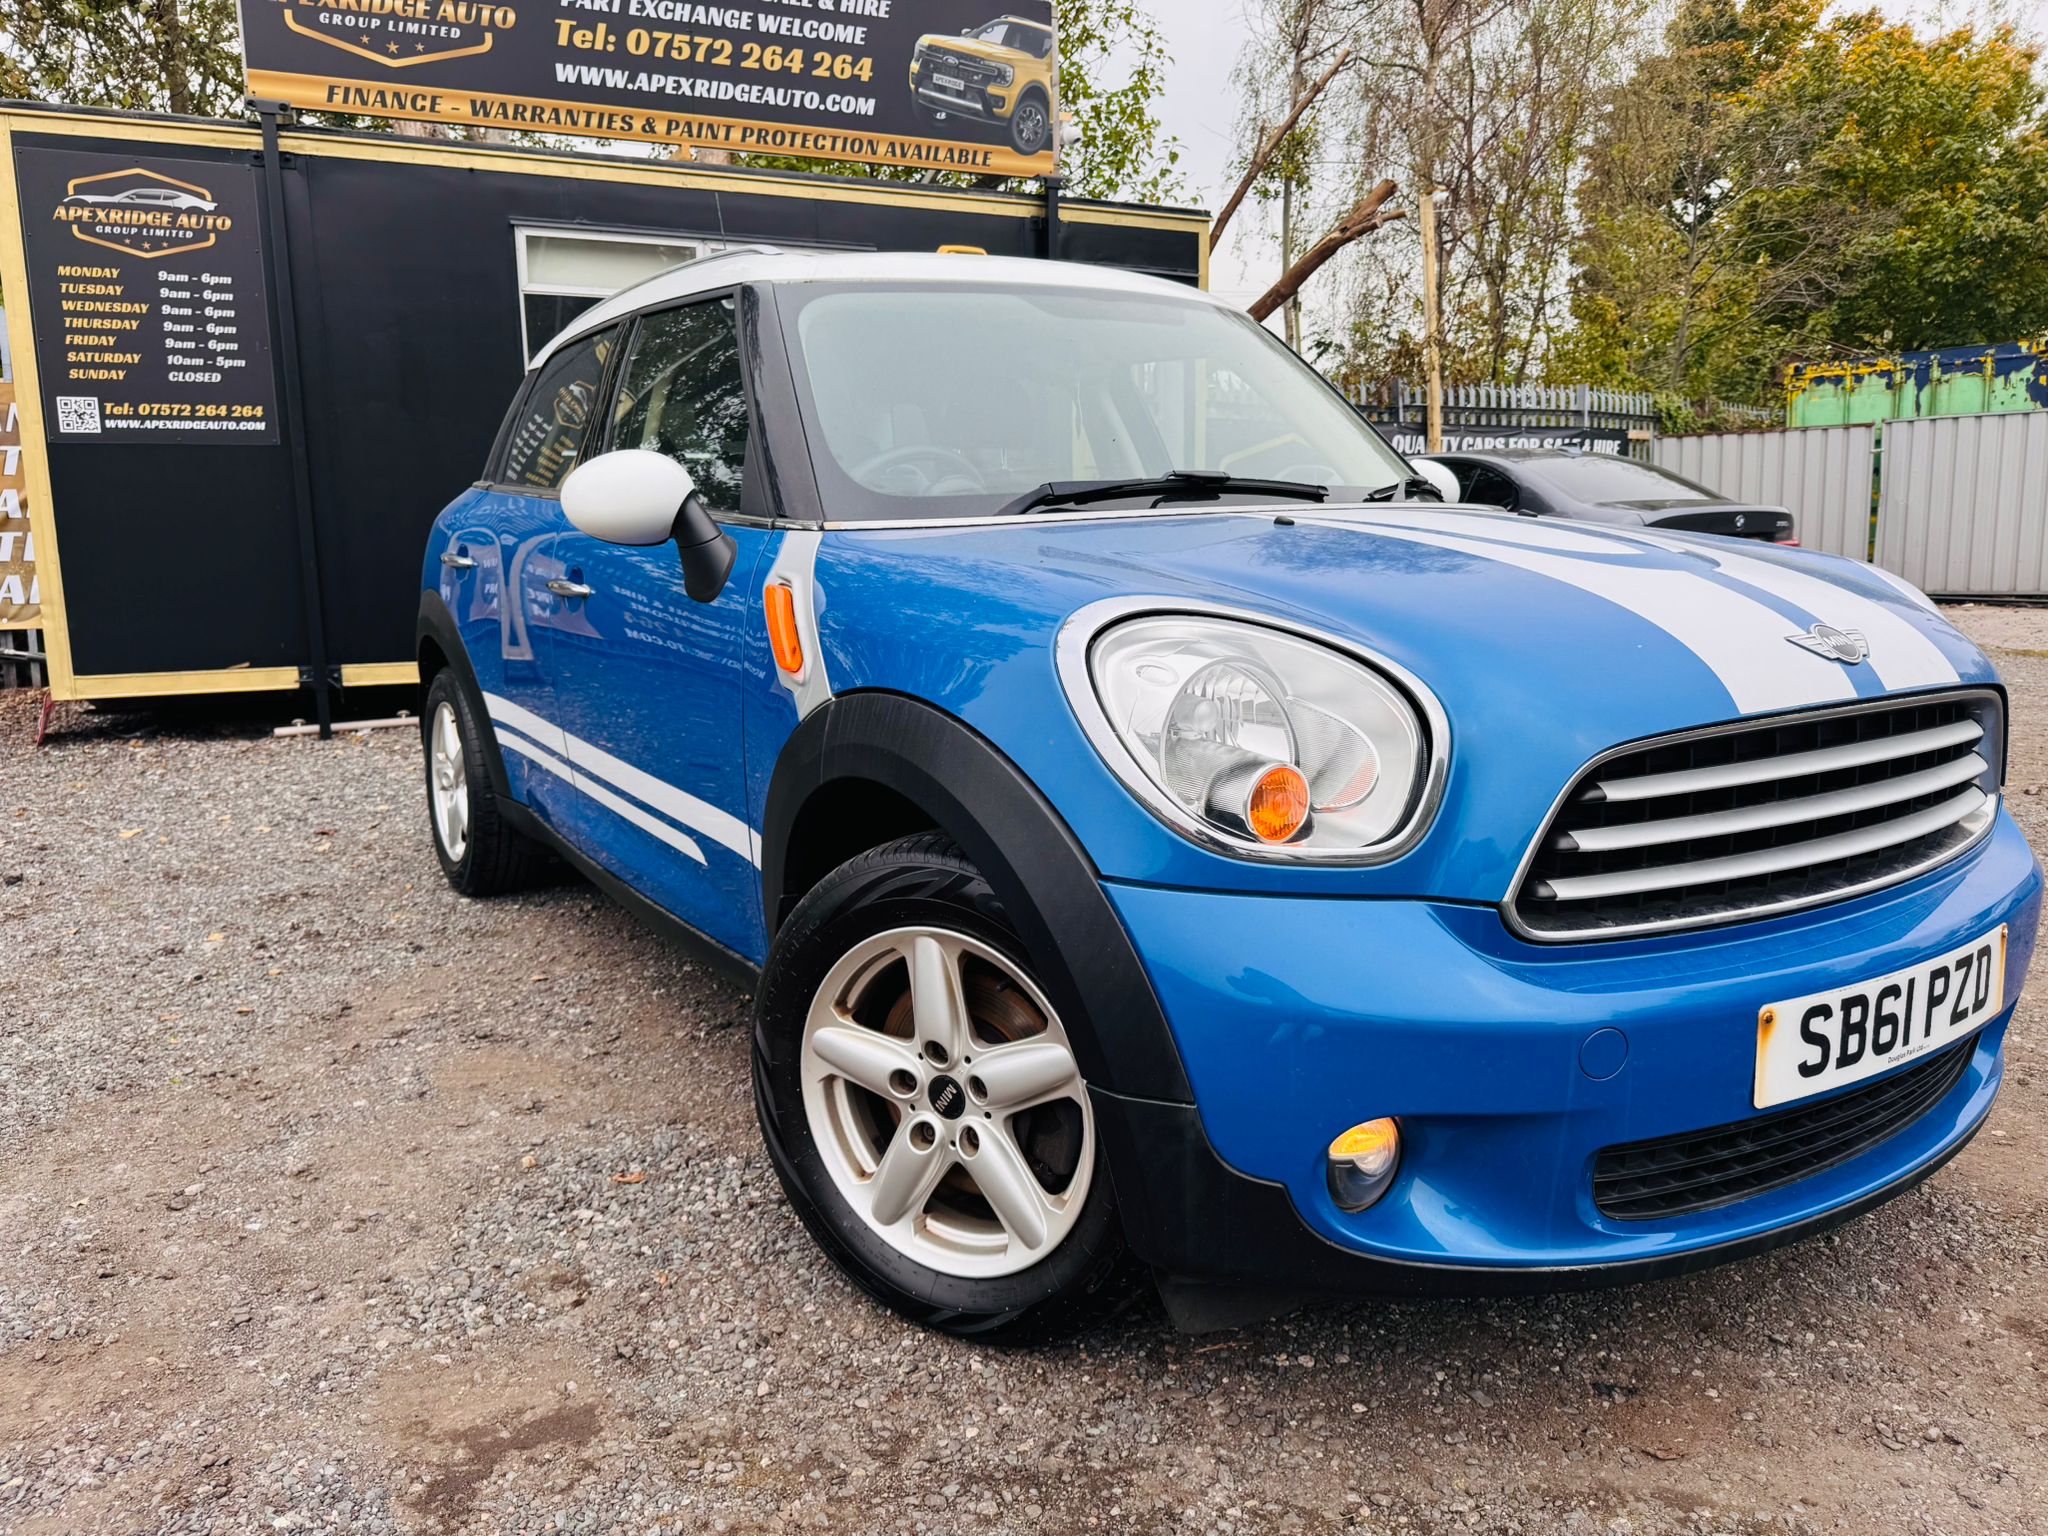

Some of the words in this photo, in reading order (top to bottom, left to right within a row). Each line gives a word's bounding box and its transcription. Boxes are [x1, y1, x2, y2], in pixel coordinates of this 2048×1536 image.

[436, 0, 516, 29] AUTO
[840, 0, 892, 18] HIRE
[319, 12, 381, 30] GROUP
[388, 20, 461, 39] LIMITED
[628, 0, 754, 31] EXCHANGE
[757, 13, 868, 45] WELCOME
[554, 18, 617, 52] Tel:
[626, 28, 733, 66] 07572
[740, 42, 804, 74] 264
[811, 51, 873, 82] 264
[554, 62, 876, 116] WWW.APEXRIDGEAUTO.COM
[326, 85, 443, 114] FINANCE
[470, 98, 634, 133] WARRANTIES
[641, 120, 657, 134] &
[665, 118, 736, 143] PAINT
[740, 125, 880, 157] PROTECTION
[883, 141, 993, 168] AVAILABLE
[53, 205, 173, 228] APEXRIDGE
[176, 213, 232, 231] AUTO
[96, 225, 138, 235] GROUP
[143, 228, 194, 239] LIMITED
[57, 265, 120, 279] MONDAY
[158, 270, 189, 282] 9am
[201, 273, 232, 285] 6pm
[60, 283, 124, 296] TUESDAY
[159, 287, 190, 299] 9am
[203, 290, 234, 302] 6pm
[61, 300, 149, 314] WEDNESDAY
[161, 304, 192, 316] 9am
[204, 307, 235, 319] 6pm
[63, 317, 139, 330] THURSDAY
[163, 321, 194, 333] 9am
[206, 324, 237, 335] 6pm
[65, 334, 117, 347] FRIDAY
[165, 338, 196, 350] 9am
[208, 340, 239, 352] 6pm
[67, 351, 142, 364] SATURDAY
[167, 355, 204, 366] 10am
[216, 356, 246, 368] 5pm
[69, 369, 126, 380] SUNDAY
[168, 371, 222, 383] CLOSED
[104, 402, 134, 416] Tel:
[138, 403, 191, 417] 07572
[195, 404, 228, 417] 264
[231, 405, 264, 418] 264
[105, 419, 266, 431] WWW.APEXRIDGEAUTO.COM
[1391, 434, 1460, 455] QUATY
[1461, 436, 1505, 451] CARS
[1593, 439, 1621, 456] HIRE
[1797, 976, 1916, 1079] SB61
[1924, 944, 1992, 1038] PZD
[935, 1083, 957, 1113] MINI
